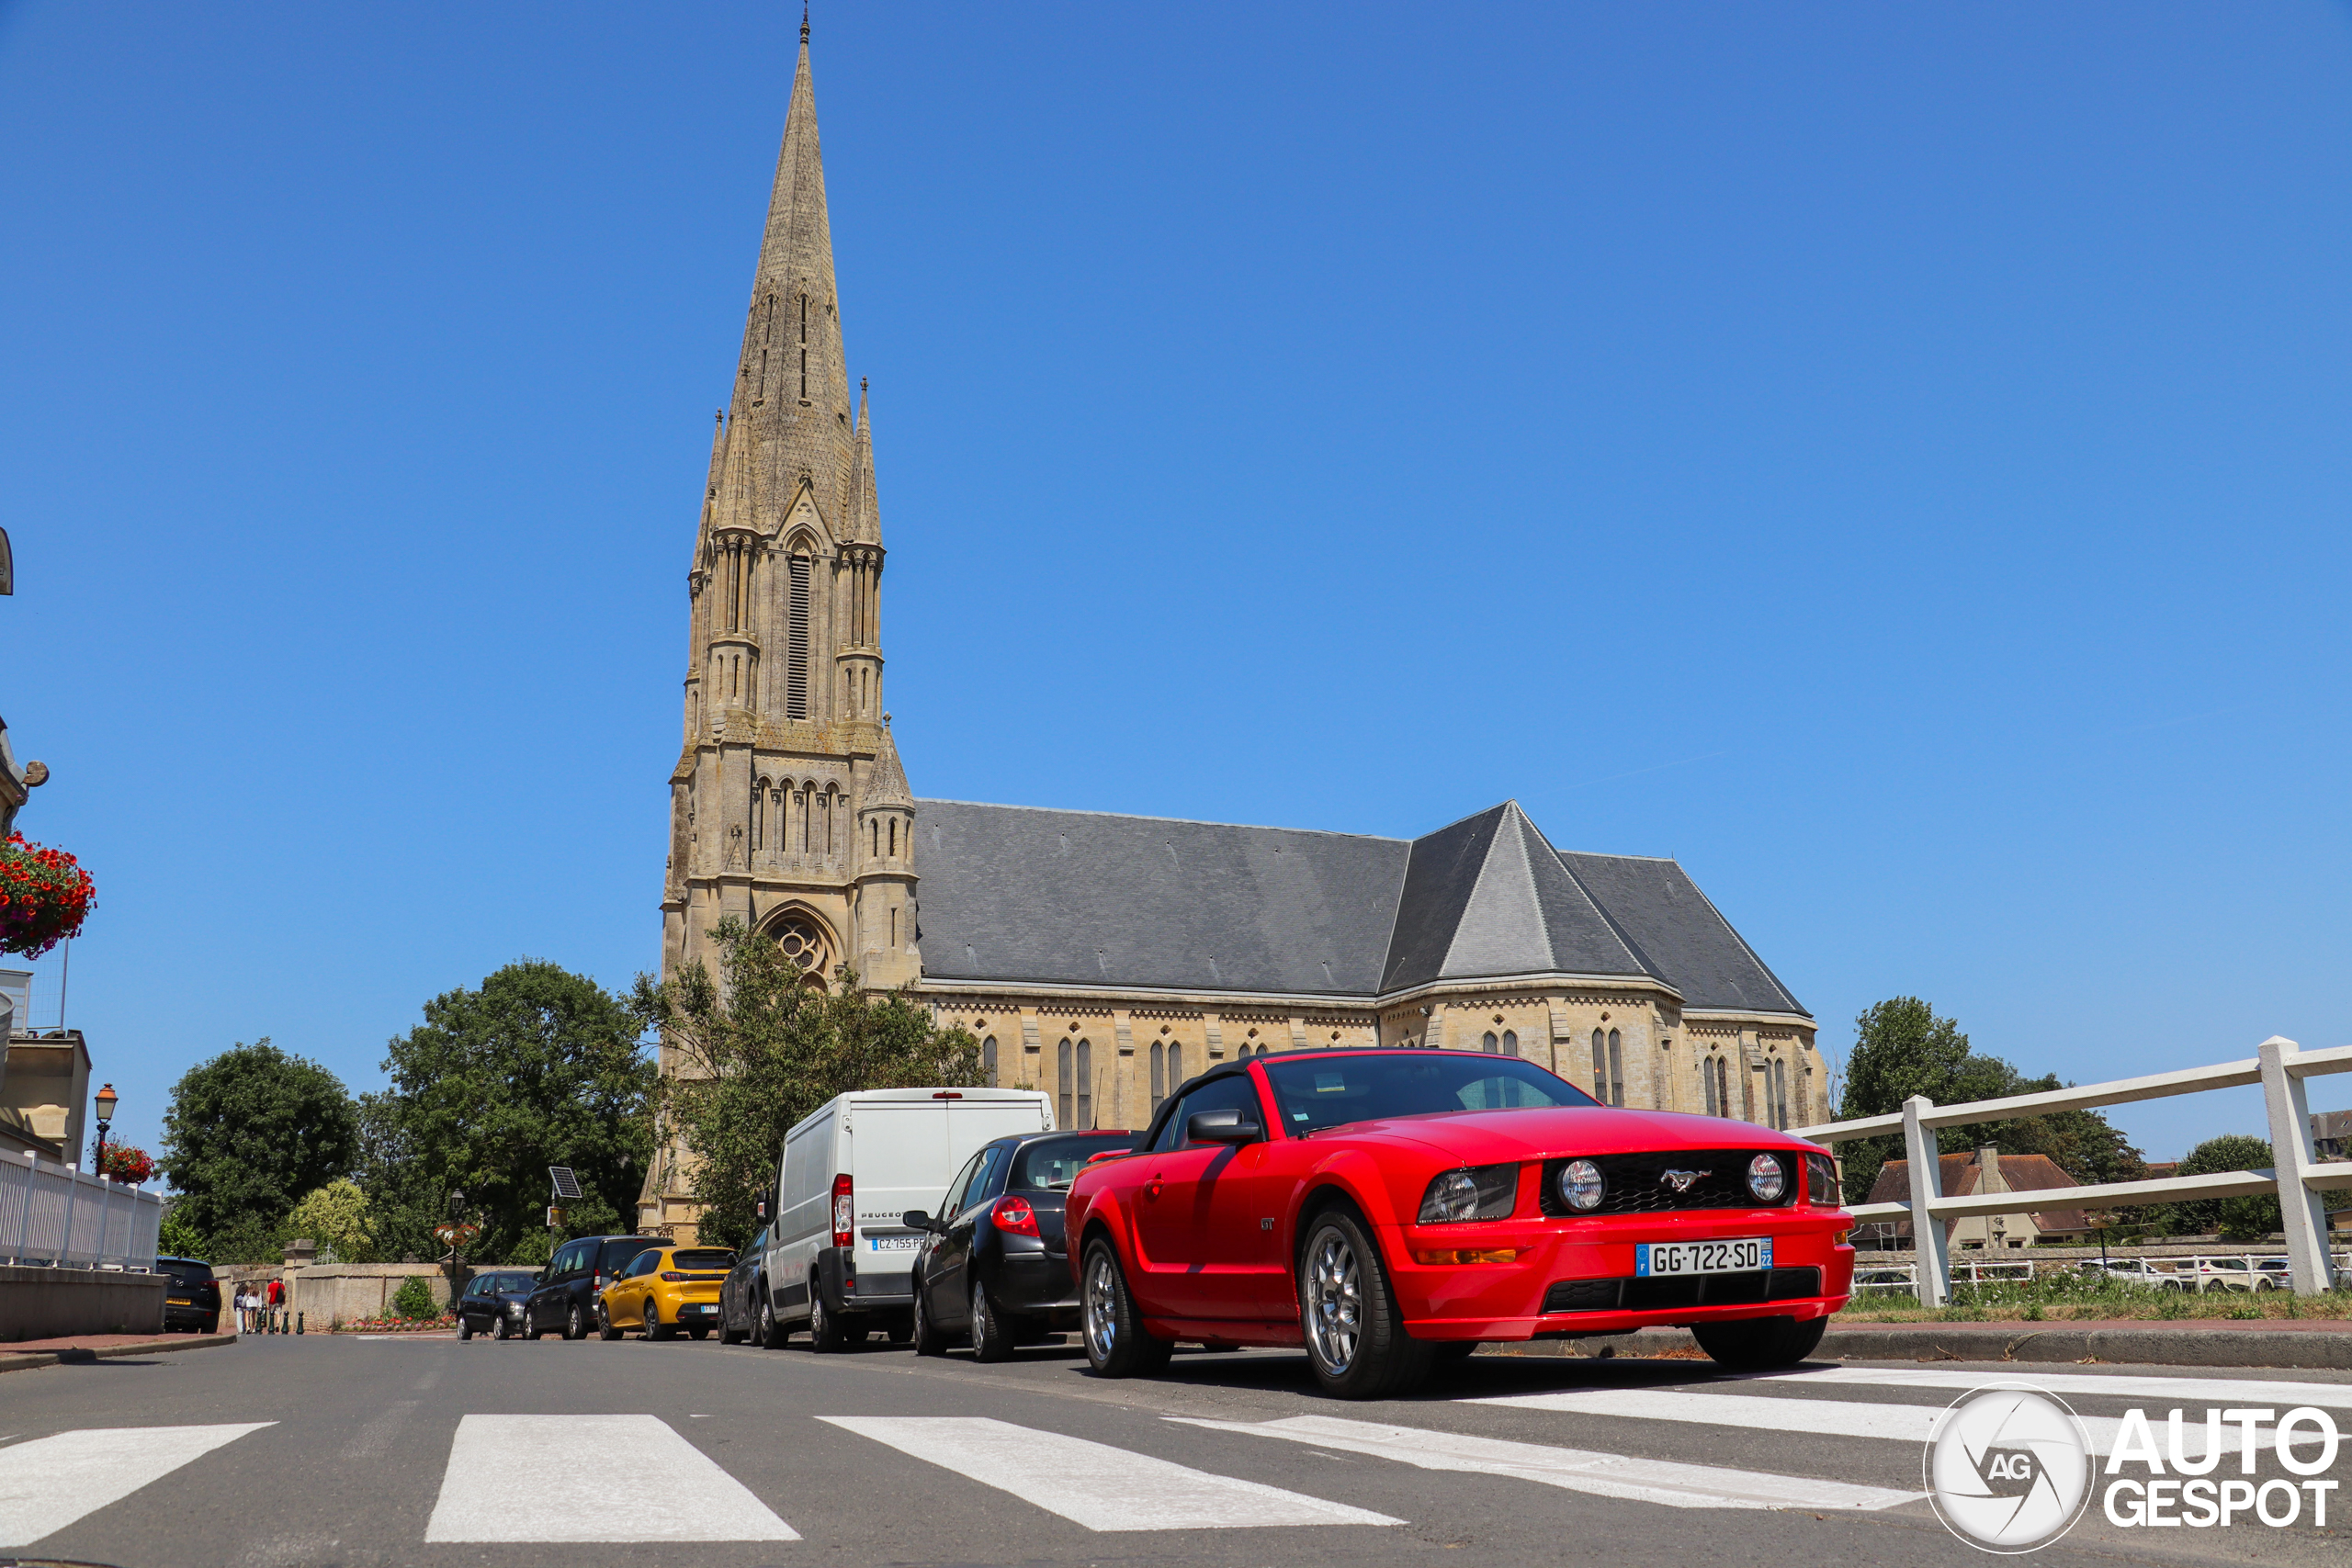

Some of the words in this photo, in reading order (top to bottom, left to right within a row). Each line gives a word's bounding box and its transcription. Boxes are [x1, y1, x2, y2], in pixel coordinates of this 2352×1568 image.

[1261, 1217, 1274, 1230] GT
[1640, 1263, 1645, 1271] F
[1654, 1242, 1758, 1272] GG-722-SD
[1761, 1254, 1772, 1267] 22
